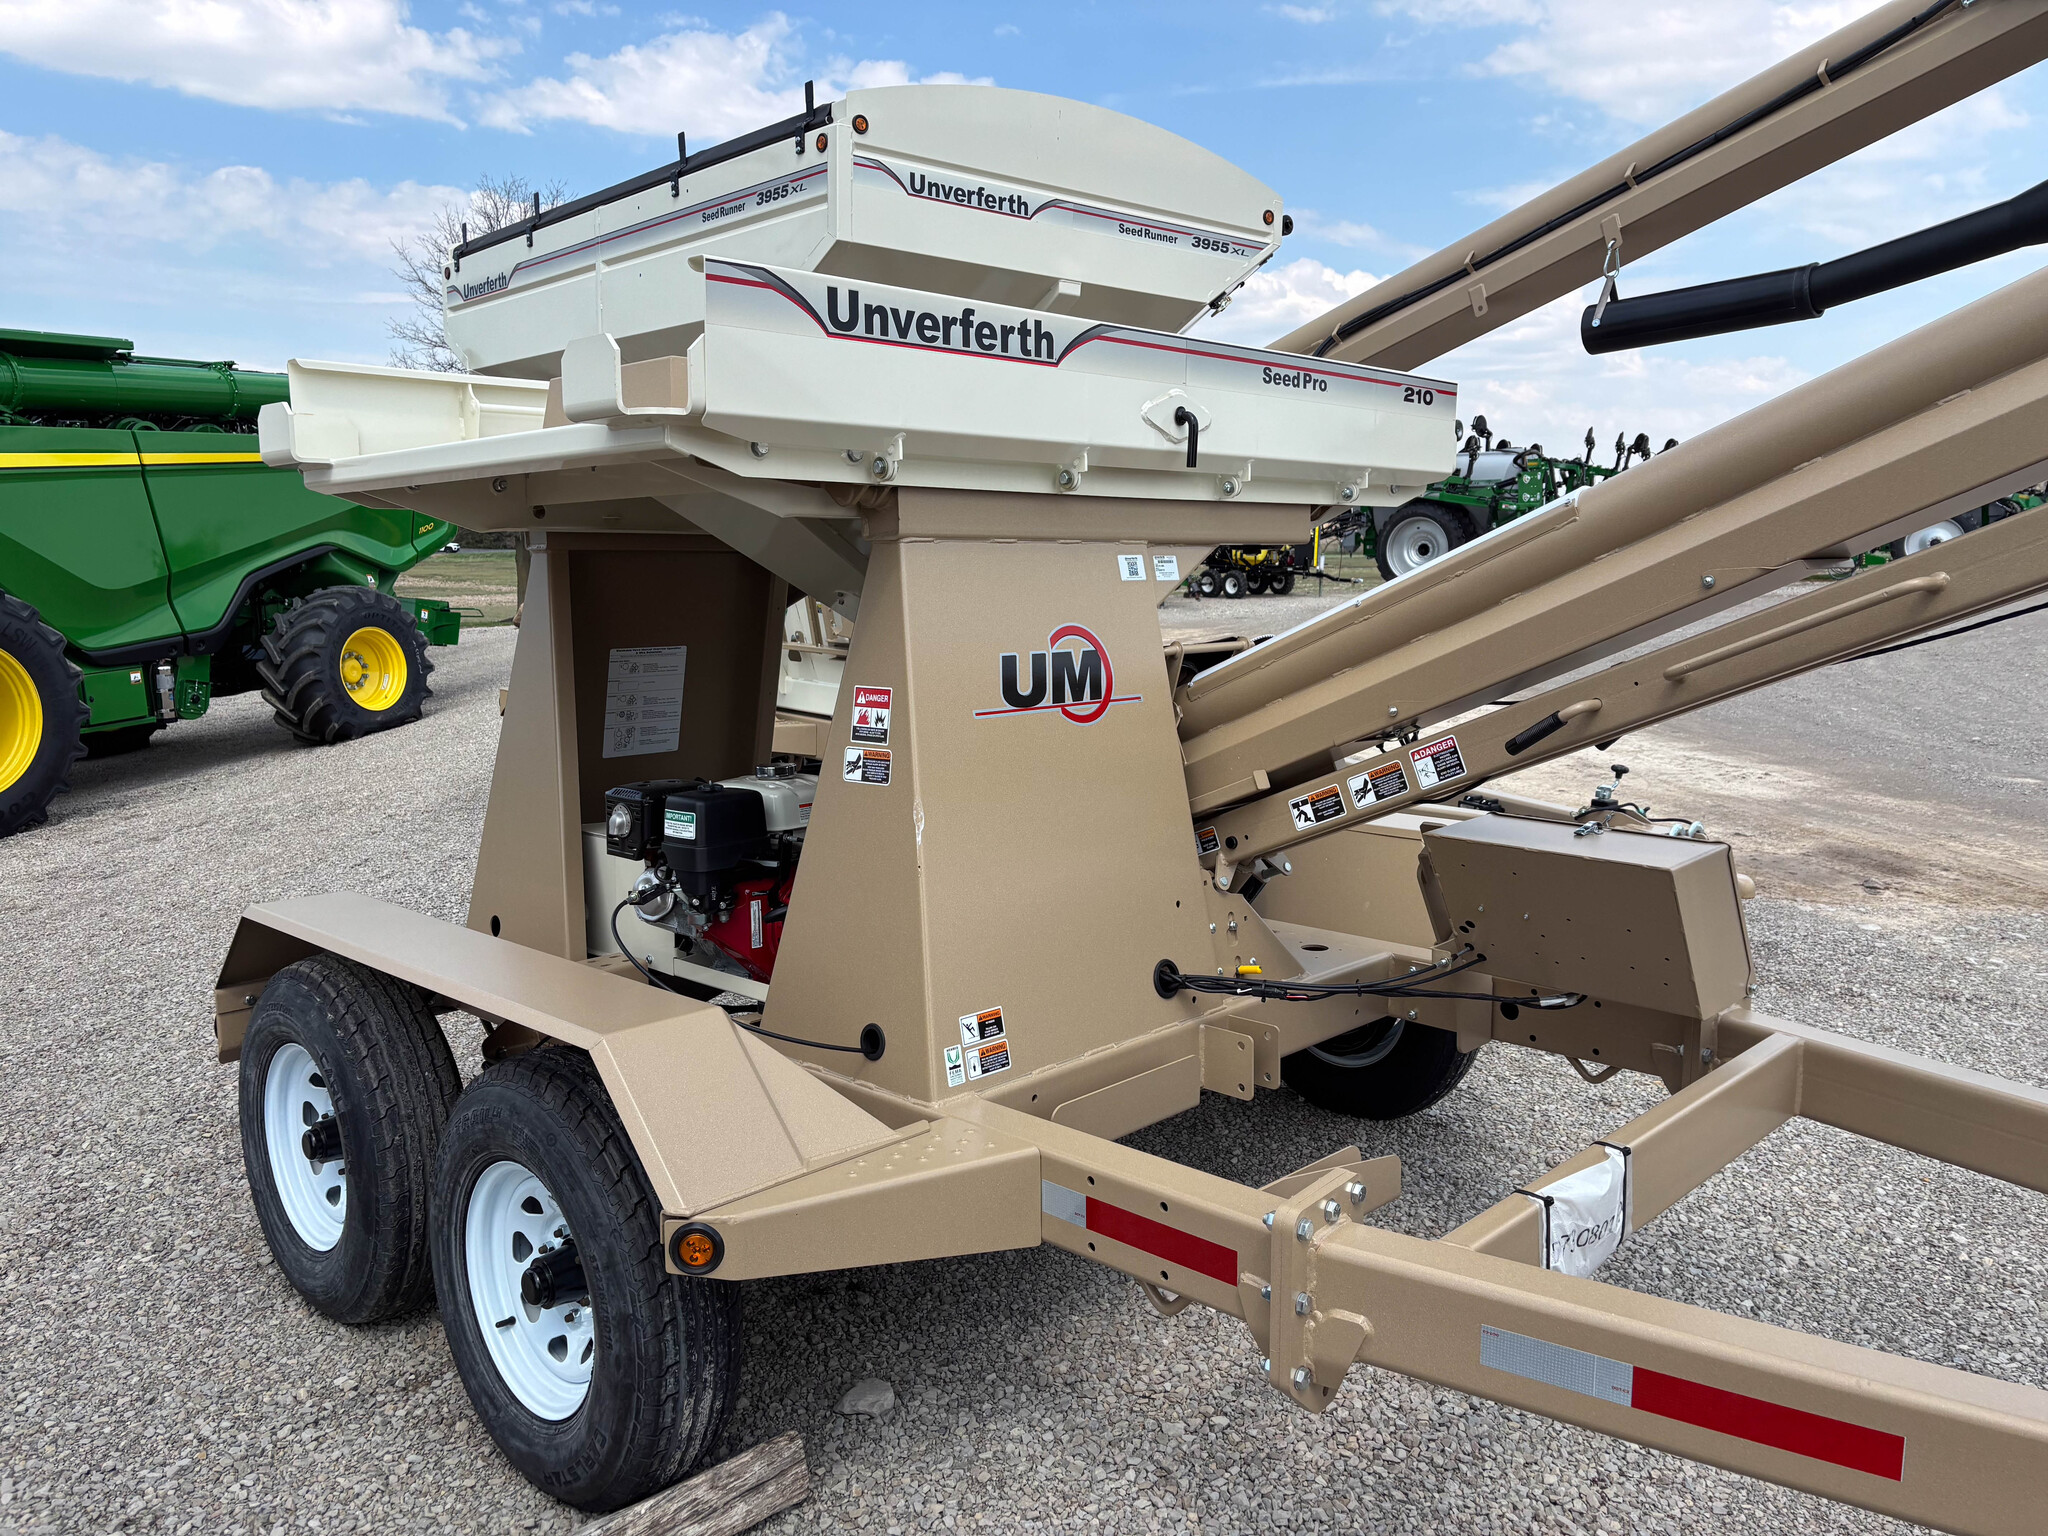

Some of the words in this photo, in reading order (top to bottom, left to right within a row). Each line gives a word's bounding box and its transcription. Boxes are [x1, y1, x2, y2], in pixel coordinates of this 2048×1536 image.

[909, 171, 1029, 216] Unverferth
[463, 272, 507, 298] Unverferth
[826, 285, 1055, 360] Unverferth
[1403, 386, 1434, 405] 210
[418, 522, 435, 535] 1100
[1002, 649, 1102, 708] UM
[865, 694, 889, 703] DANGER
[868, 750, 891, 760] WARNING
[1420, 739, 1454, 758] DANGER
[1375, 763, 1400, 777] WARNING
